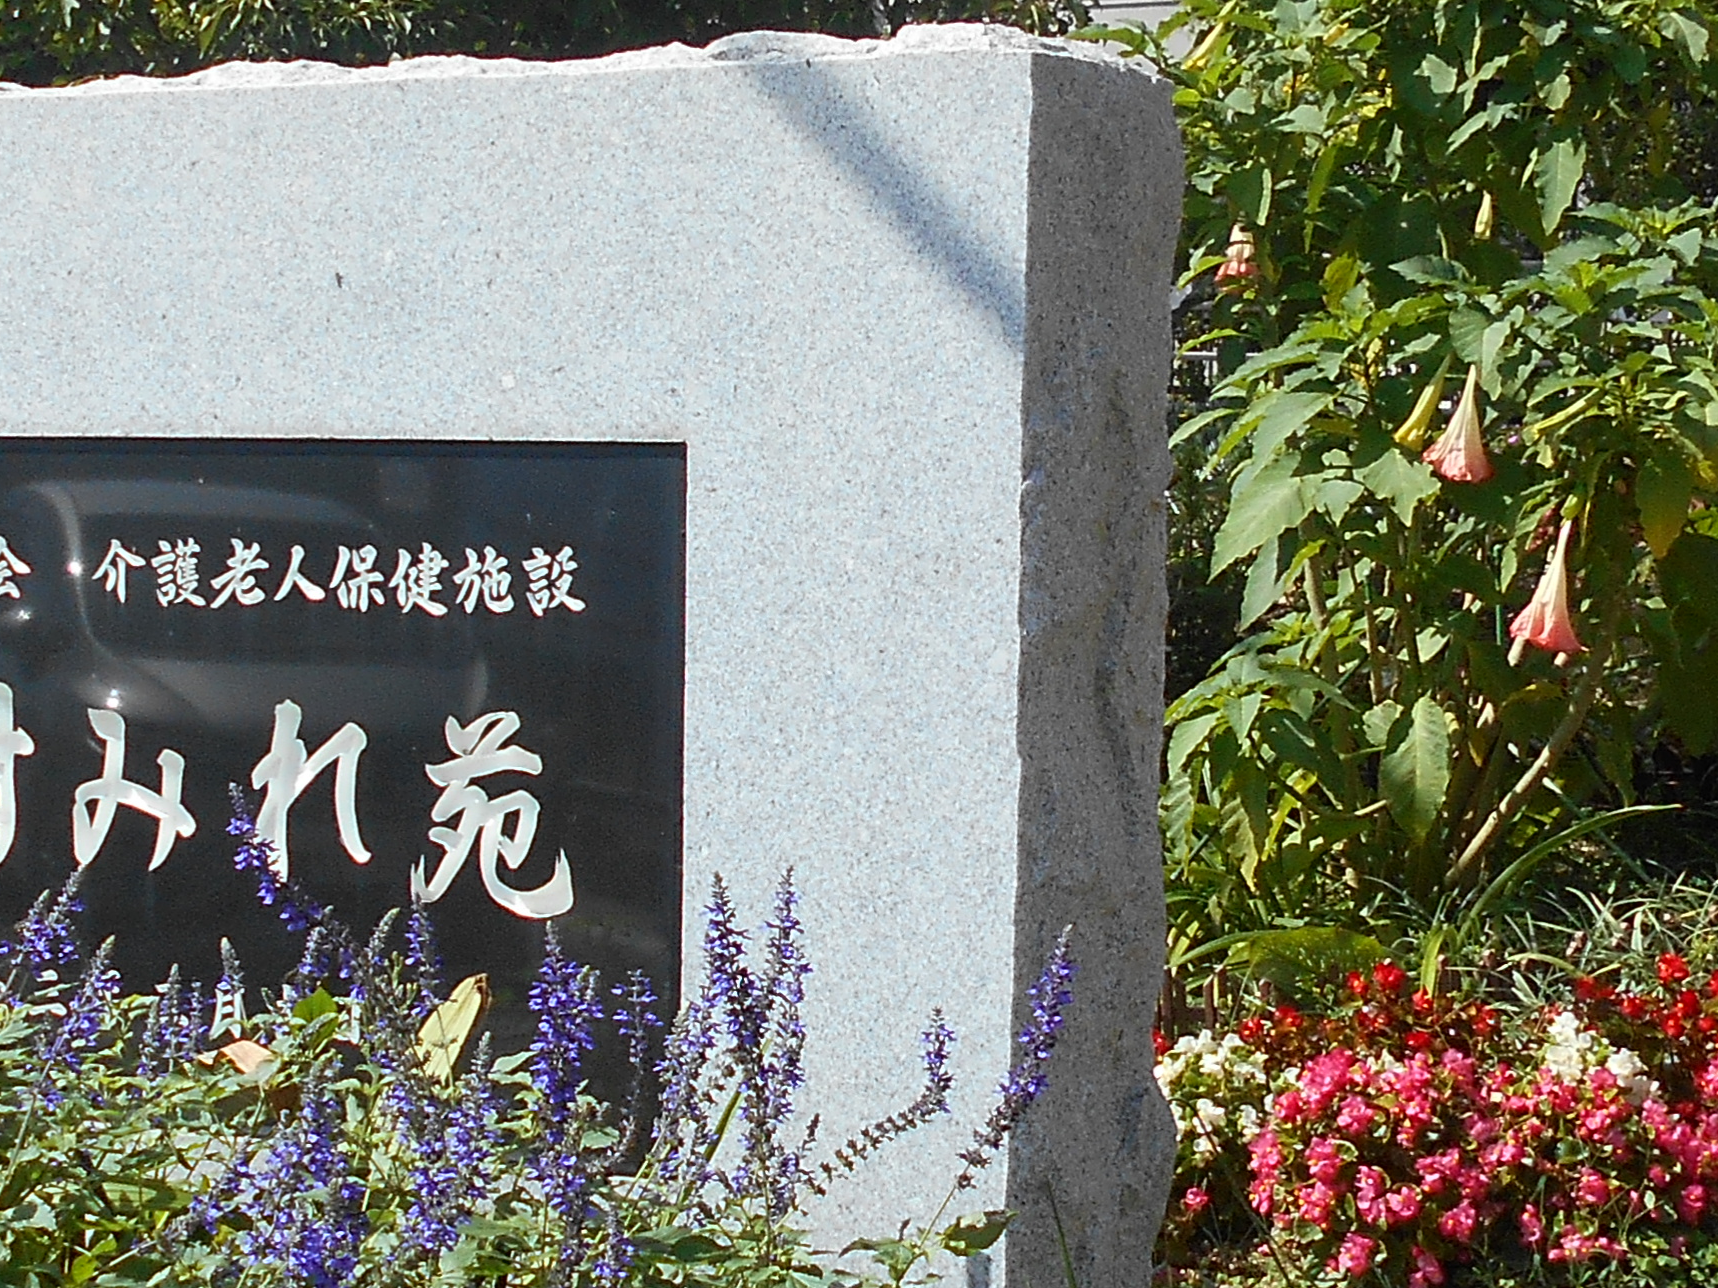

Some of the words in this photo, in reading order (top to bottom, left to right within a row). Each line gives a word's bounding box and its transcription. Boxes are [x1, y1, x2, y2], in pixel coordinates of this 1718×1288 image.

[91, 537, 586, 616] 介護老人保健施設
